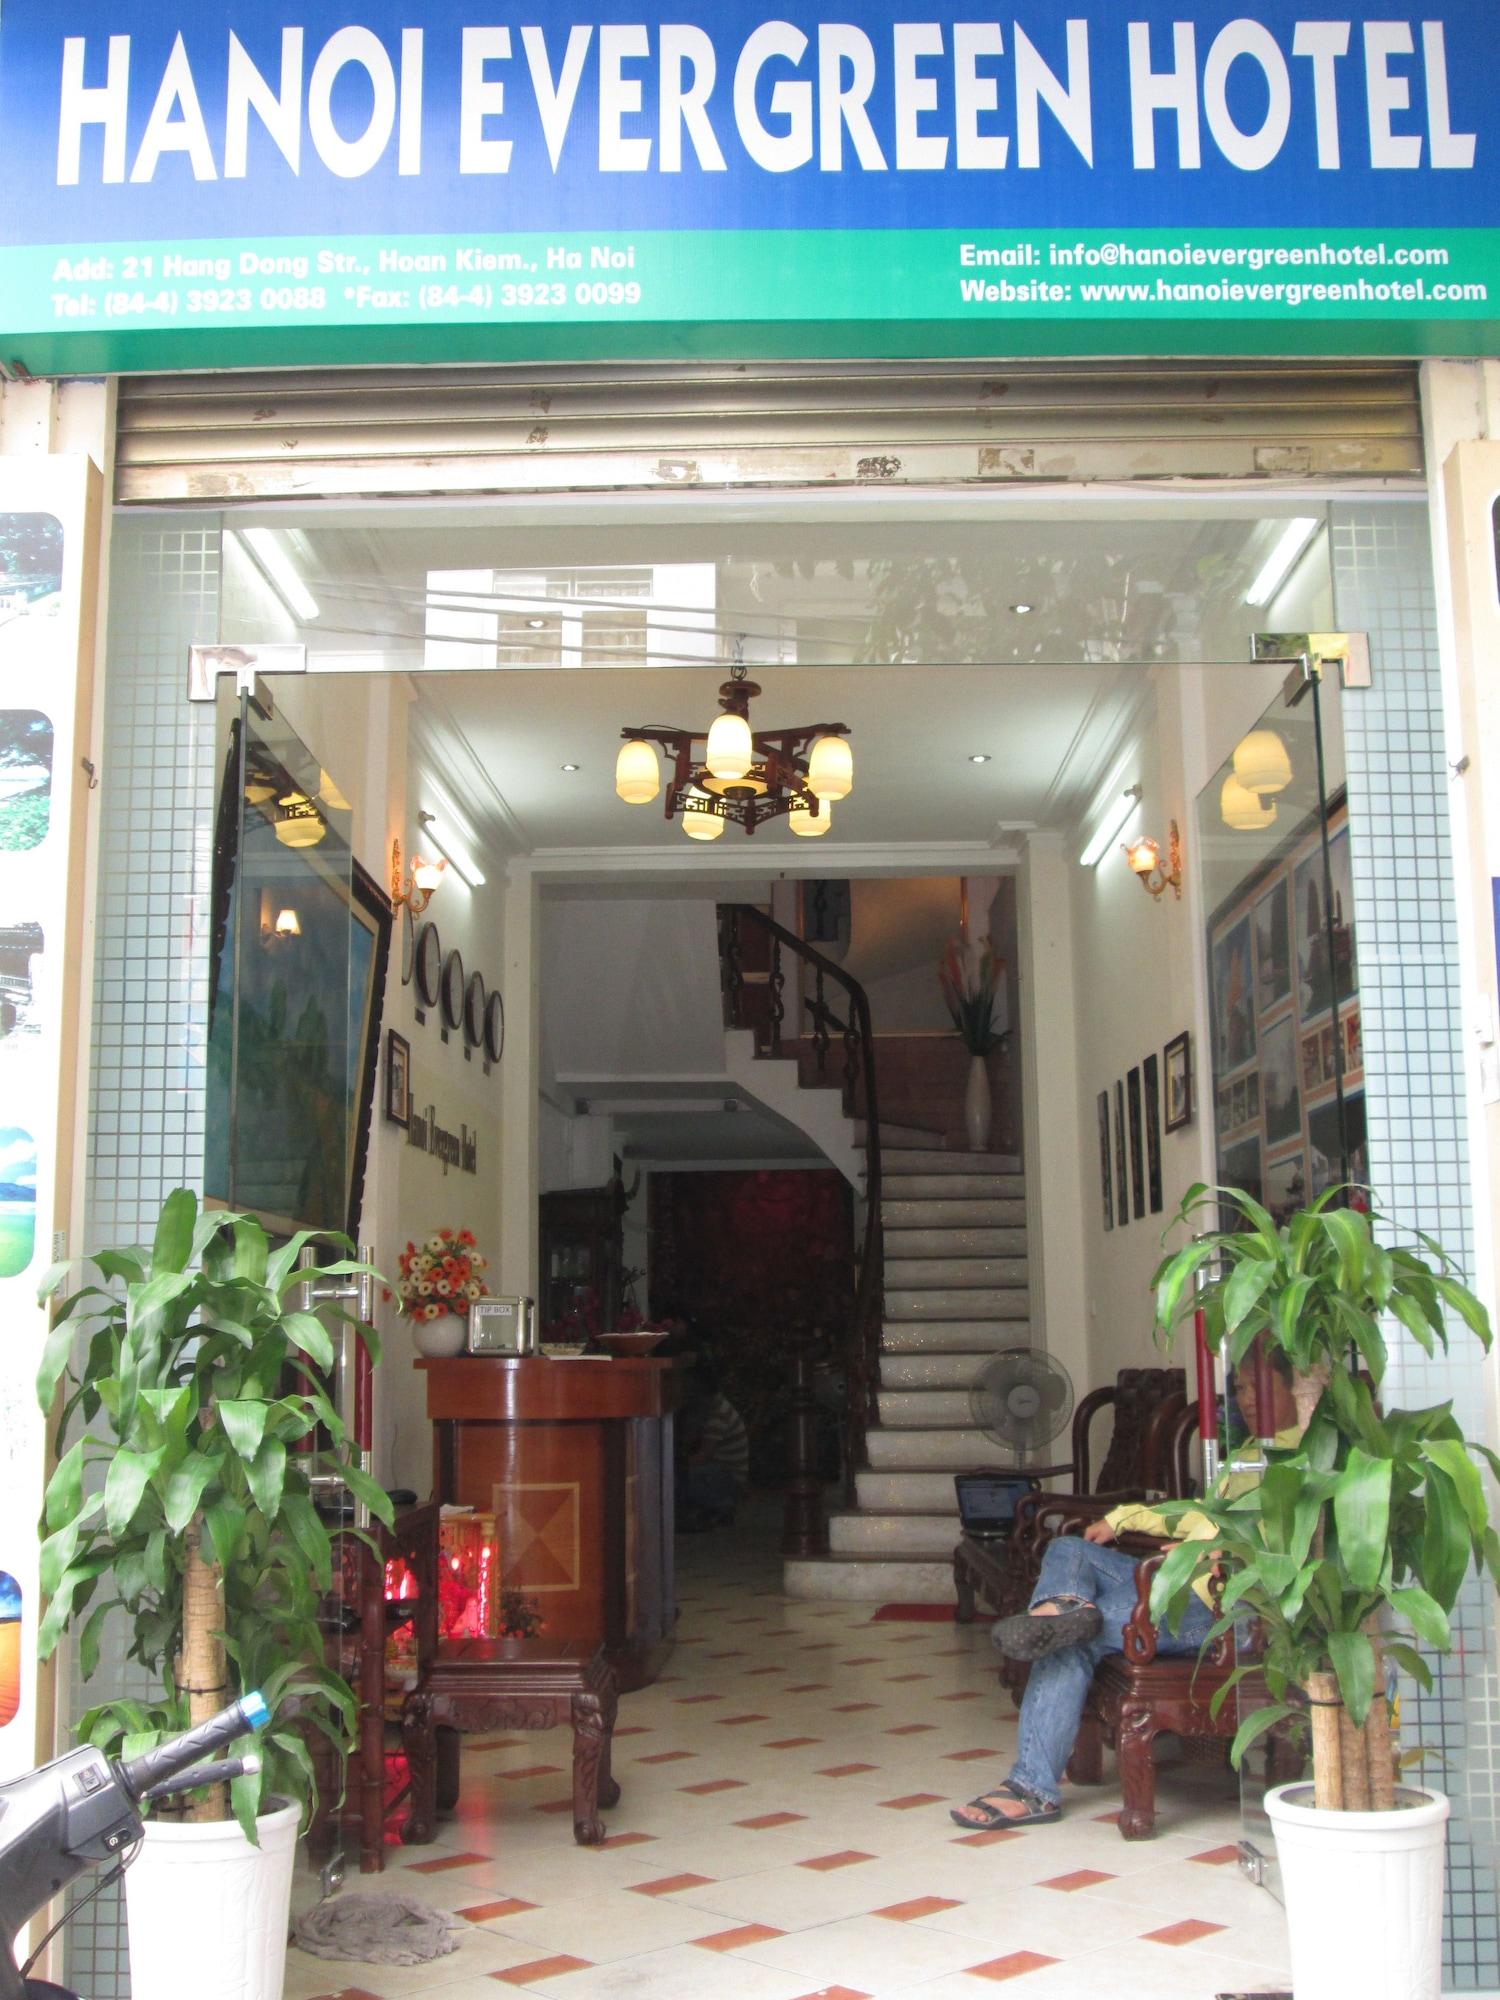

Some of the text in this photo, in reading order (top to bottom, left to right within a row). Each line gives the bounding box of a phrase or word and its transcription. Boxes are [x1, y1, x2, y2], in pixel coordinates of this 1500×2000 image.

[57, 18, 1476, 186] HANOI EVERGREEN HOTEL
[52, 246, 635, 281] Add: 21 Hang Dong Str., Hoan Kiem., Ha Noi
[960, 243, 1449, 270] Email: info@hanoievergreenhotel.com
[51, 292, 97, 318] Tel:
[104, 290, 178, 318] (84-4)
[186, 288, 253, 313] 3923
[260, 286, 327, 311] 0088
[418, 284, 493, 310] (84-4)
[501, 283, 567, 306] 3923
[575, 281, 642, 305] 0099
[960, 278, 1487, 305] Website: www.hanoievergreenhotel.com
[480, 1306, 511, 1314] TIP BOX
